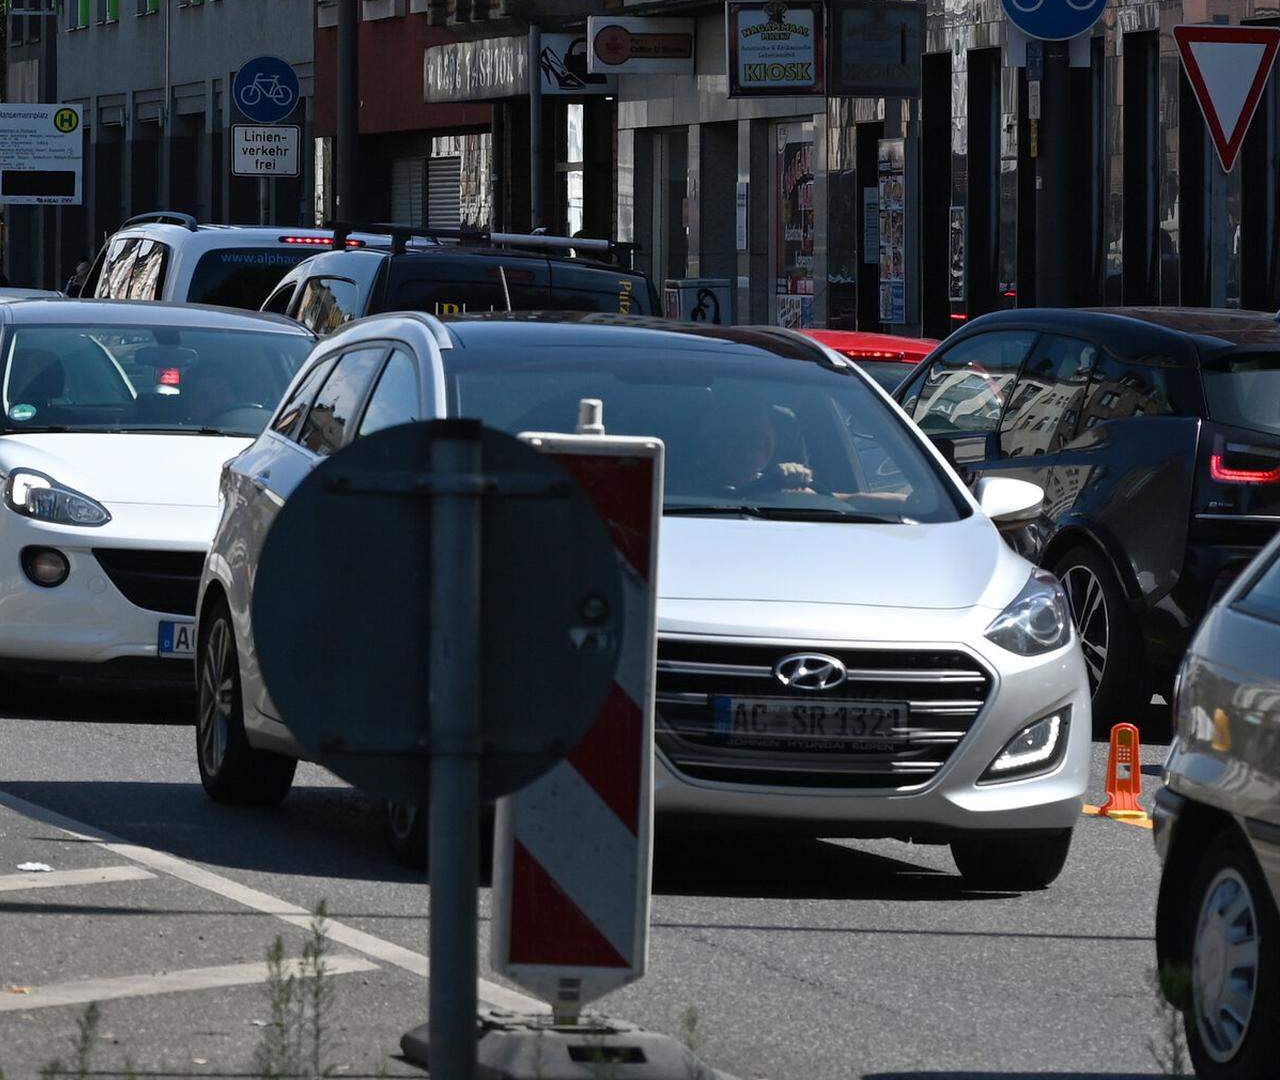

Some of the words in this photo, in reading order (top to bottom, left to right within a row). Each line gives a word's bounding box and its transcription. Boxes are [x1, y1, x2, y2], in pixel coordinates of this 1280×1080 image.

[743, 63, 813, 82] KIOSK
[244, 130, 287, 142] Linien-
[242, 146, 289, 157] verkehr
[255, 158, 276, 170] frei
[175, 626, 196, 650] A
[734, 703, 768, 733] AC
[791, 705, 826, 736] SR
[787, 740, 845, 750] HYUNDAI
